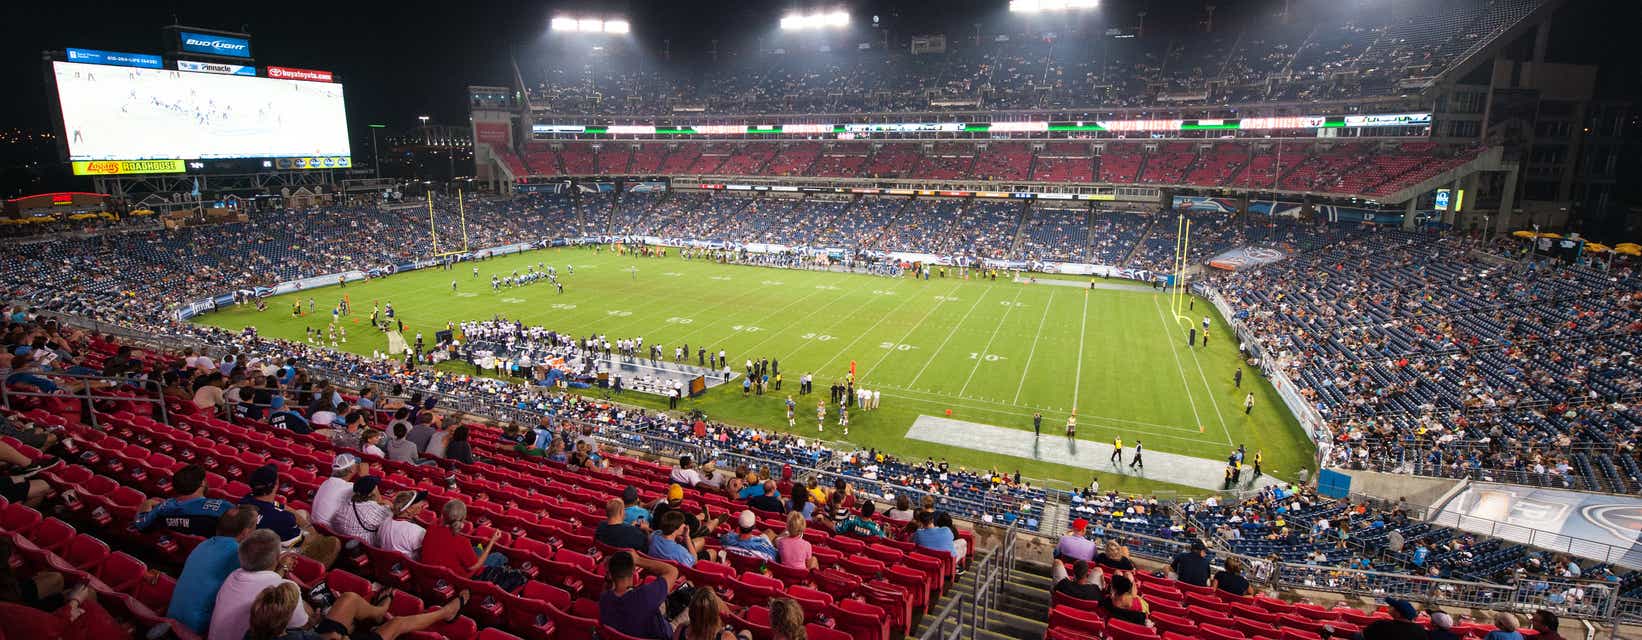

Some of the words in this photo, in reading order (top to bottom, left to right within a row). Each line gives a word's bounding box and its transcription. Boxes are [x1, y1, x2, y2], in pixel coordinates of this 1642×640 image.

[212, 41, 246, 50] LIGHT
[201, 64, 231, 72] Pinnacle
[122, 161, 176, 172] ROADHOUSE
[880, 342, 911, 351] 20
[969, 352, 999, 361] 10
